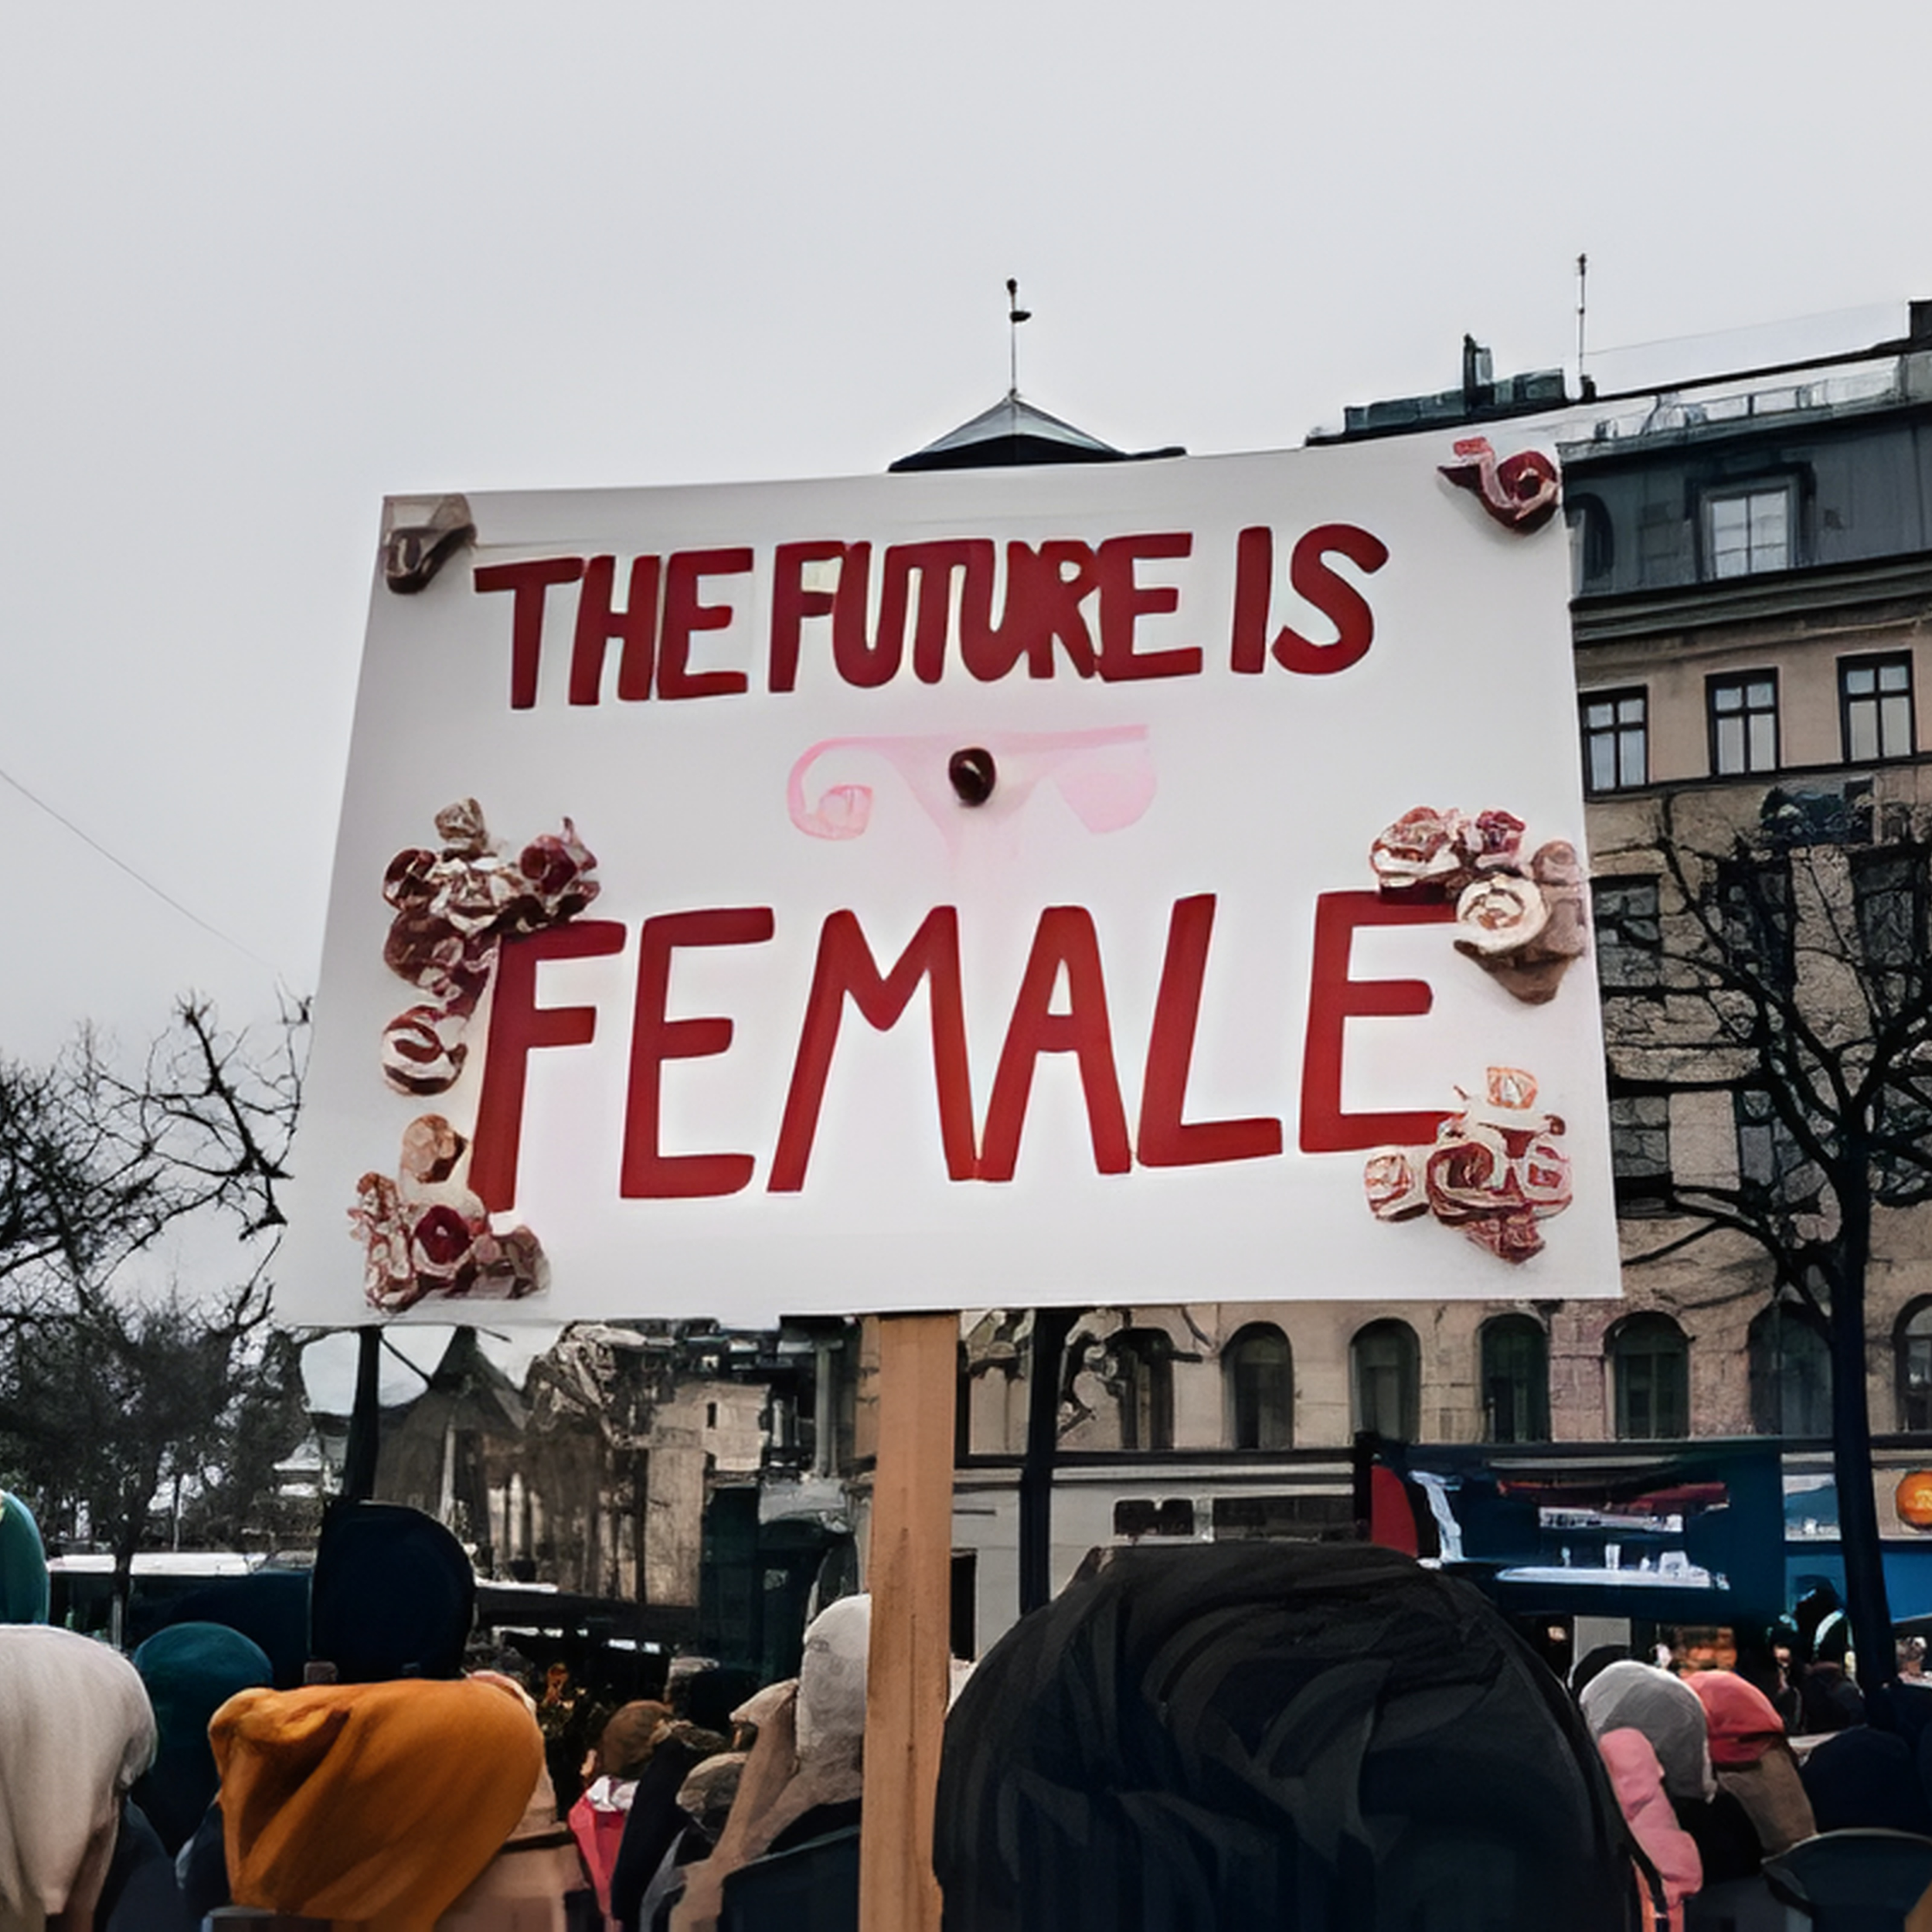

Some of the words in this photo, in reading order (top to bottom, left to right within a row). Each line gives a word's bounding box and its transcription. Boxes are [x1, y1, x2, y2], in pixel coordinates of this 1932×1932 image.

[474, 547, 754, 710] THE
[767, 532, 1203, 693] FUTURE
[1230, 523, 1389, 675] IS
[468, 891, 1454, 1213] FEMALE
